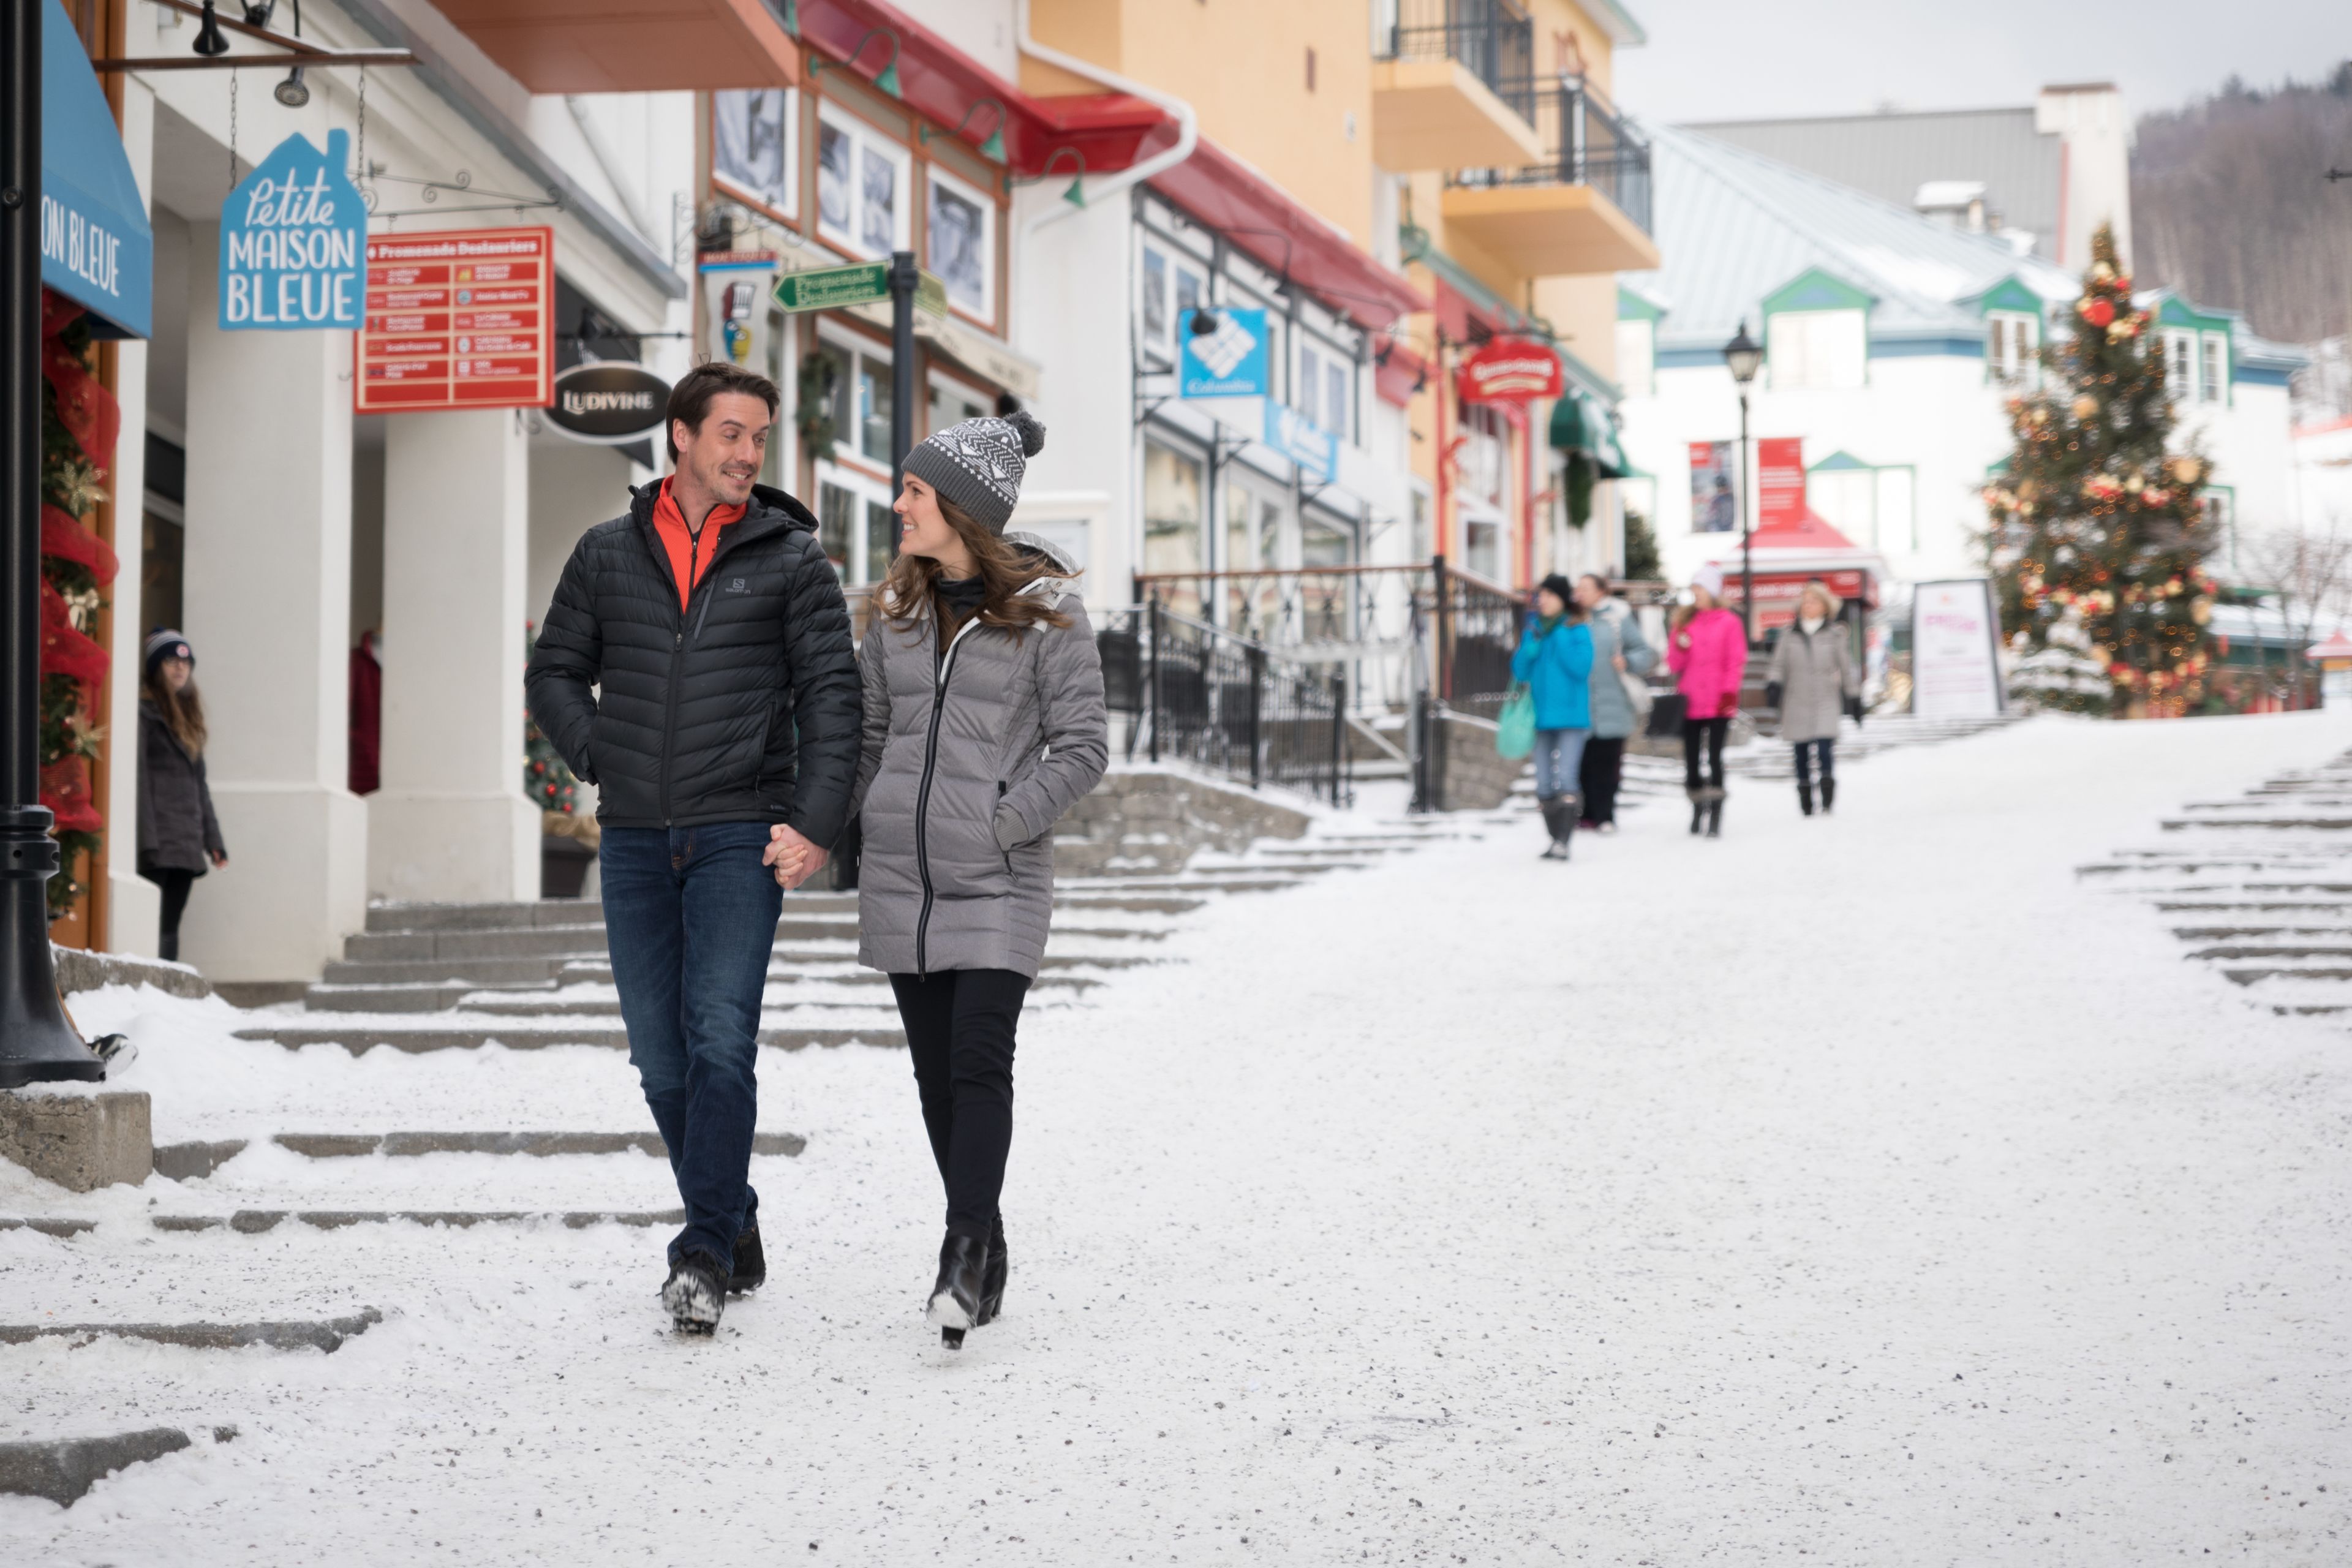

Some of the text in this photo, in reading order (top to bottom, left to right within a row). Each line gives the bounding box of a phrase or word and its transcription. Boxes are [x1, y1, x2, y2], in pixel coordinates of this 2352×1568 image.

[245, 167, 334, 227] Petite
[69, 209, 120, 298] BLEUE
[228, 228, 356, 270] MAISON
[379, 239, 537, 258] Promenade Deslauriers
[796, 268, 876, 290] Promenade
[796, 284, 877, 305] Deslauriers
[227, 273, 356, 323] BLEUE
[1187, 377, 1256, 394] Columbia
